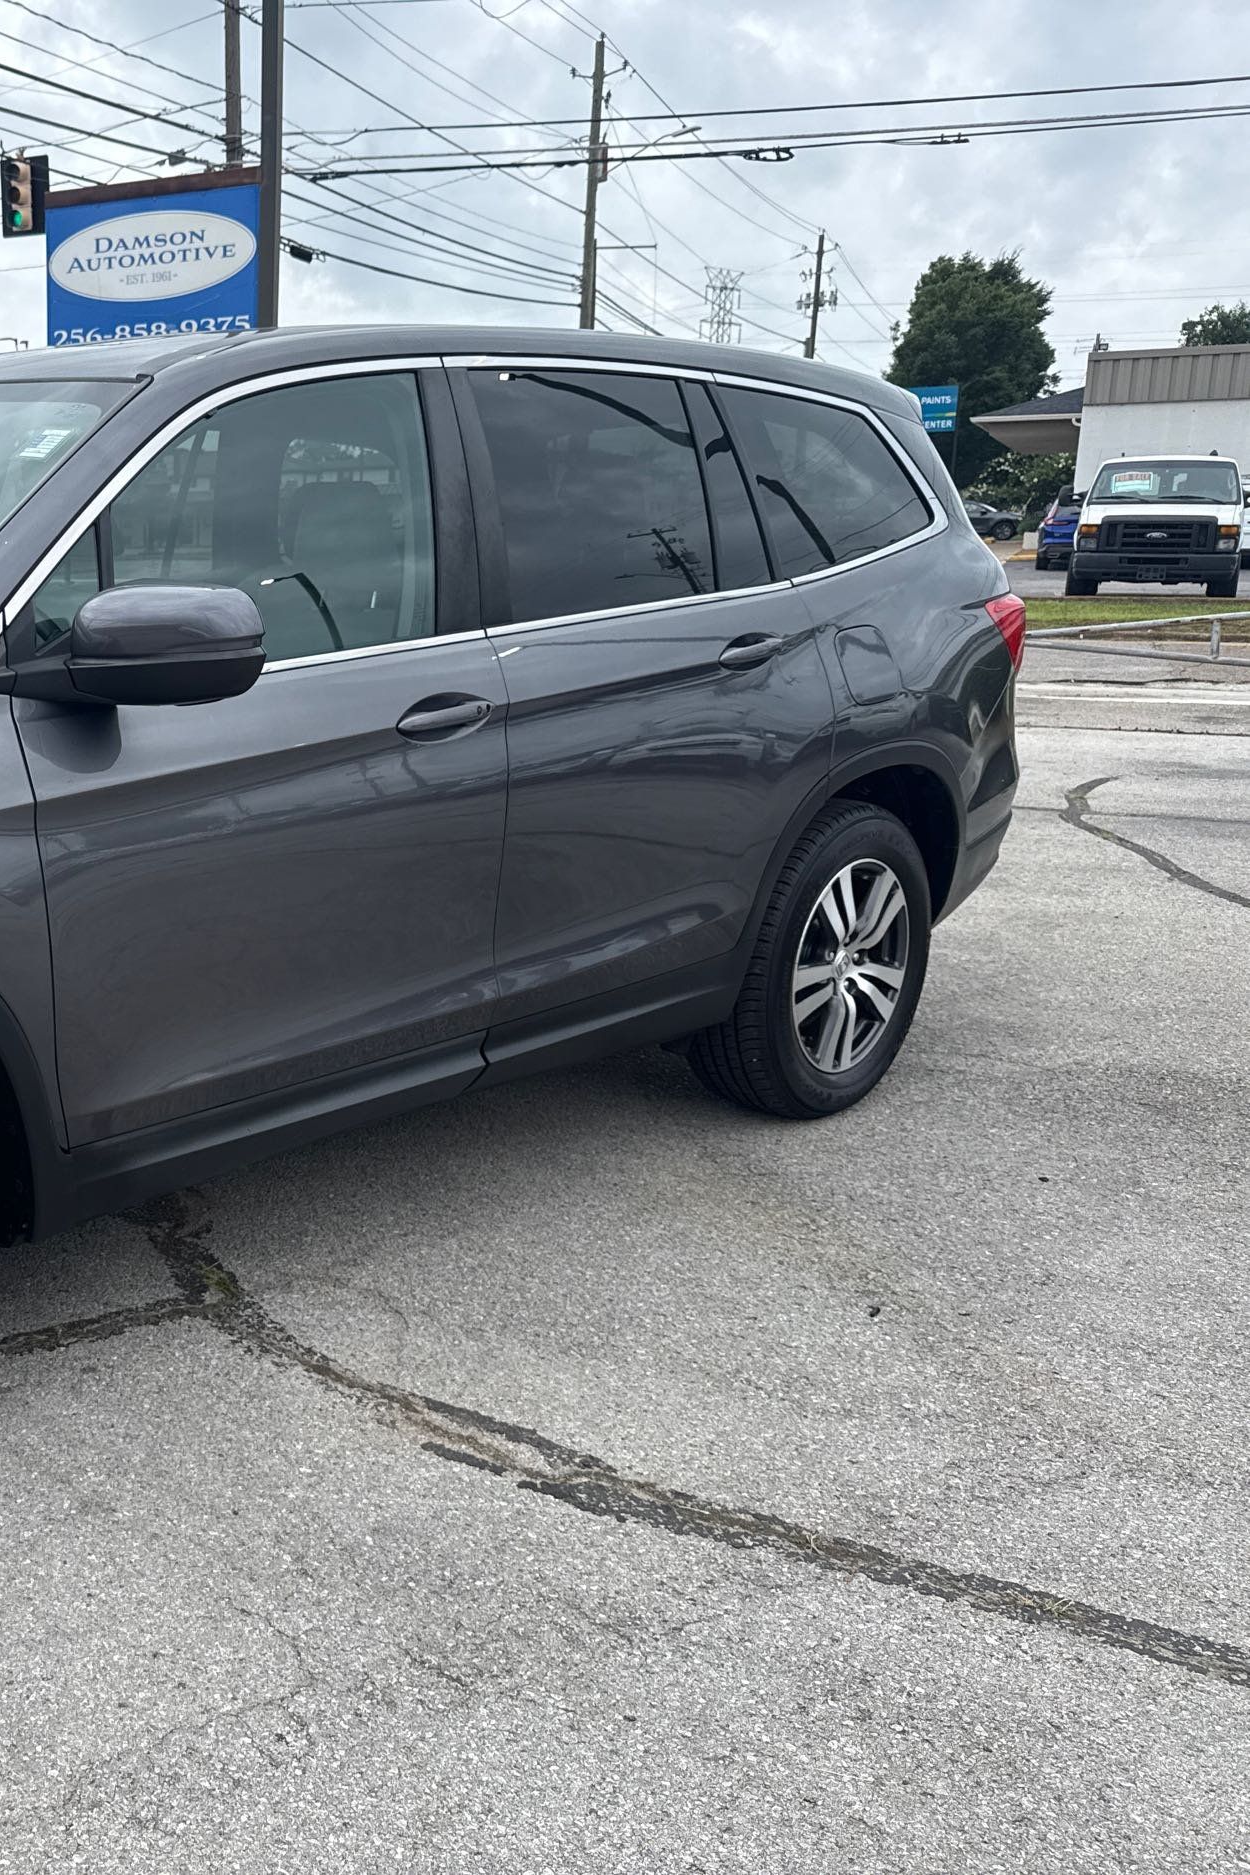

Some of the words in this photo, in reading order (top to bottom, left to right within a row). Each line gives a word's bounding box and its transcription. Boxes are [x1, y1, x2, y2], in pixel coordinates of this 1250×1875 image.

[94, 230, 206, 254] DAMSON
[66, 243, 236, 274] AUTOMOTIVE
[53, 315, 251, 348] 256-858-9375
[921, 395, 952, 405] PAINTS
[923, 420, 953, 430] ENTER
